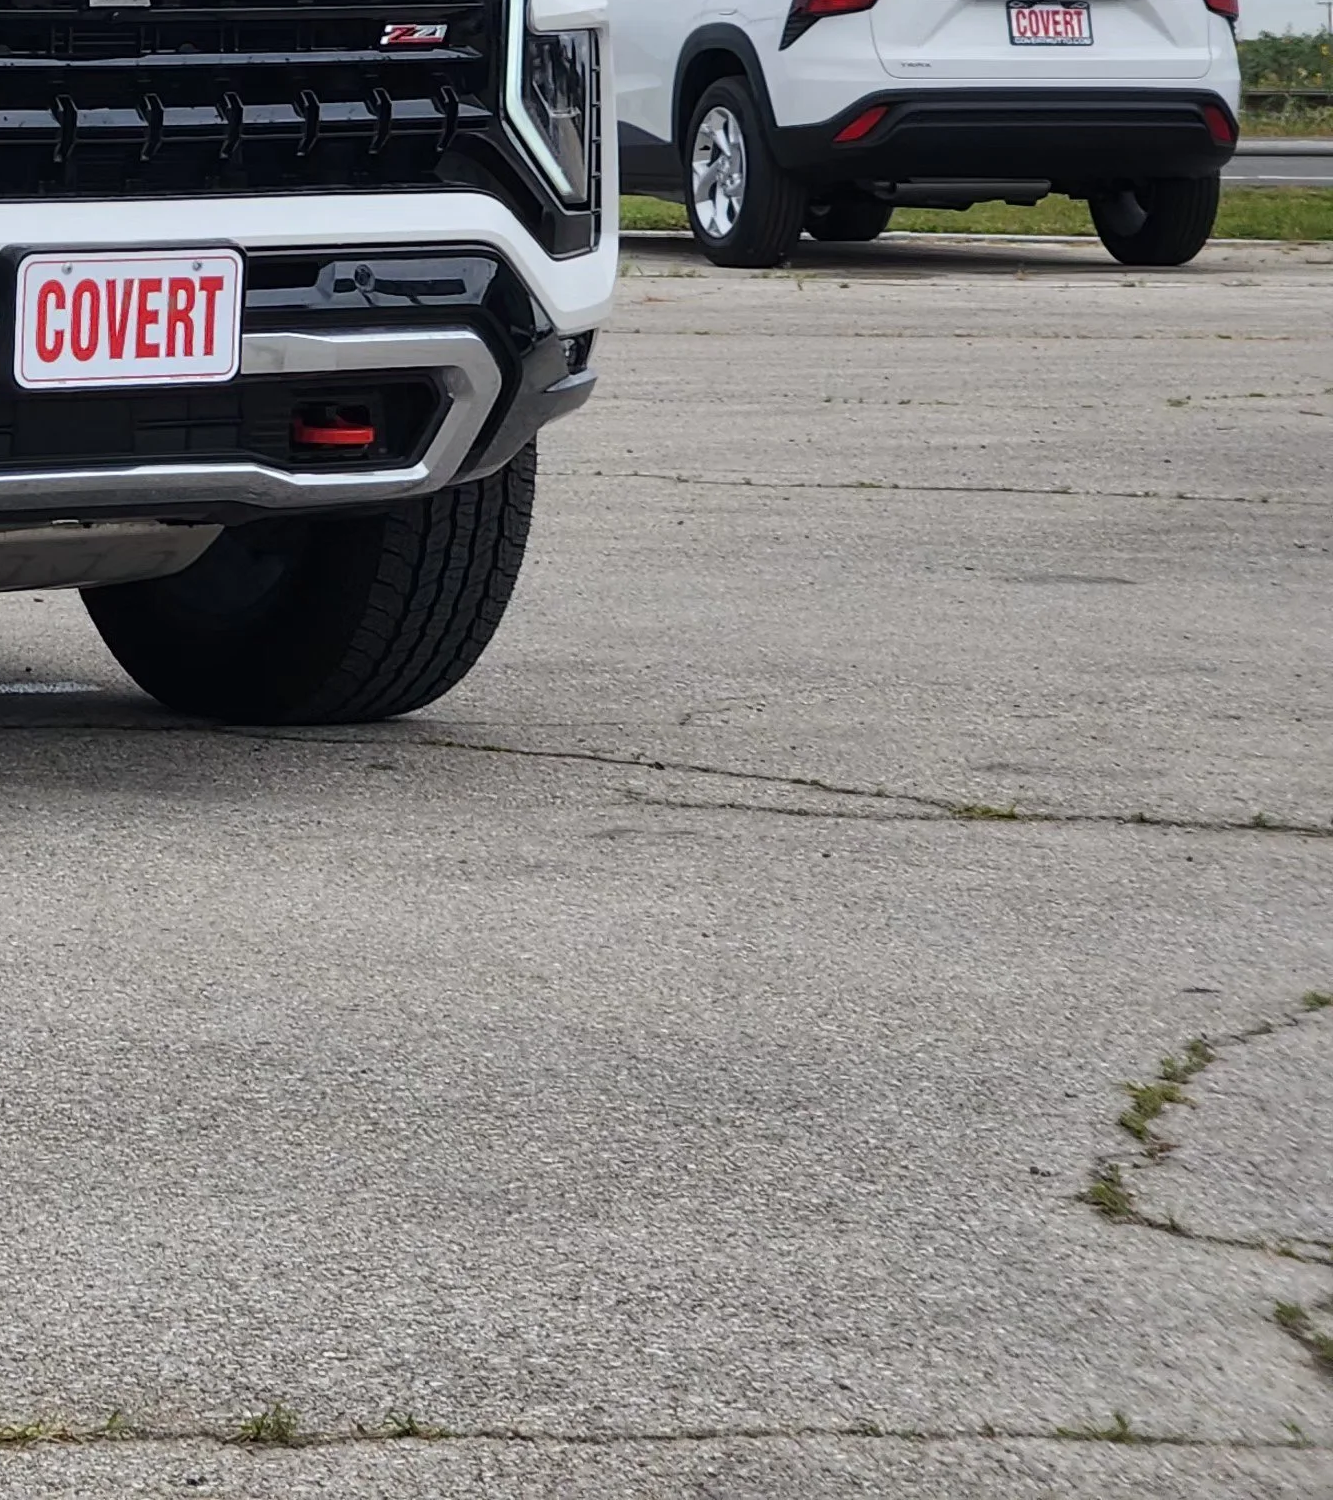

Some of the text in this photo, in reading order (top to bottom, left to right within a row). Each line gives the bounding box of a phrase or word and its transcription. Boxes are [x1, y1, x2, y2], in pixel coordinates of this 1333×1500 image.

[379, 24, 448, 45] Z71
[1015, 9, 1084, 37] COVERT
[35, 275, 225, 363] COVERT
